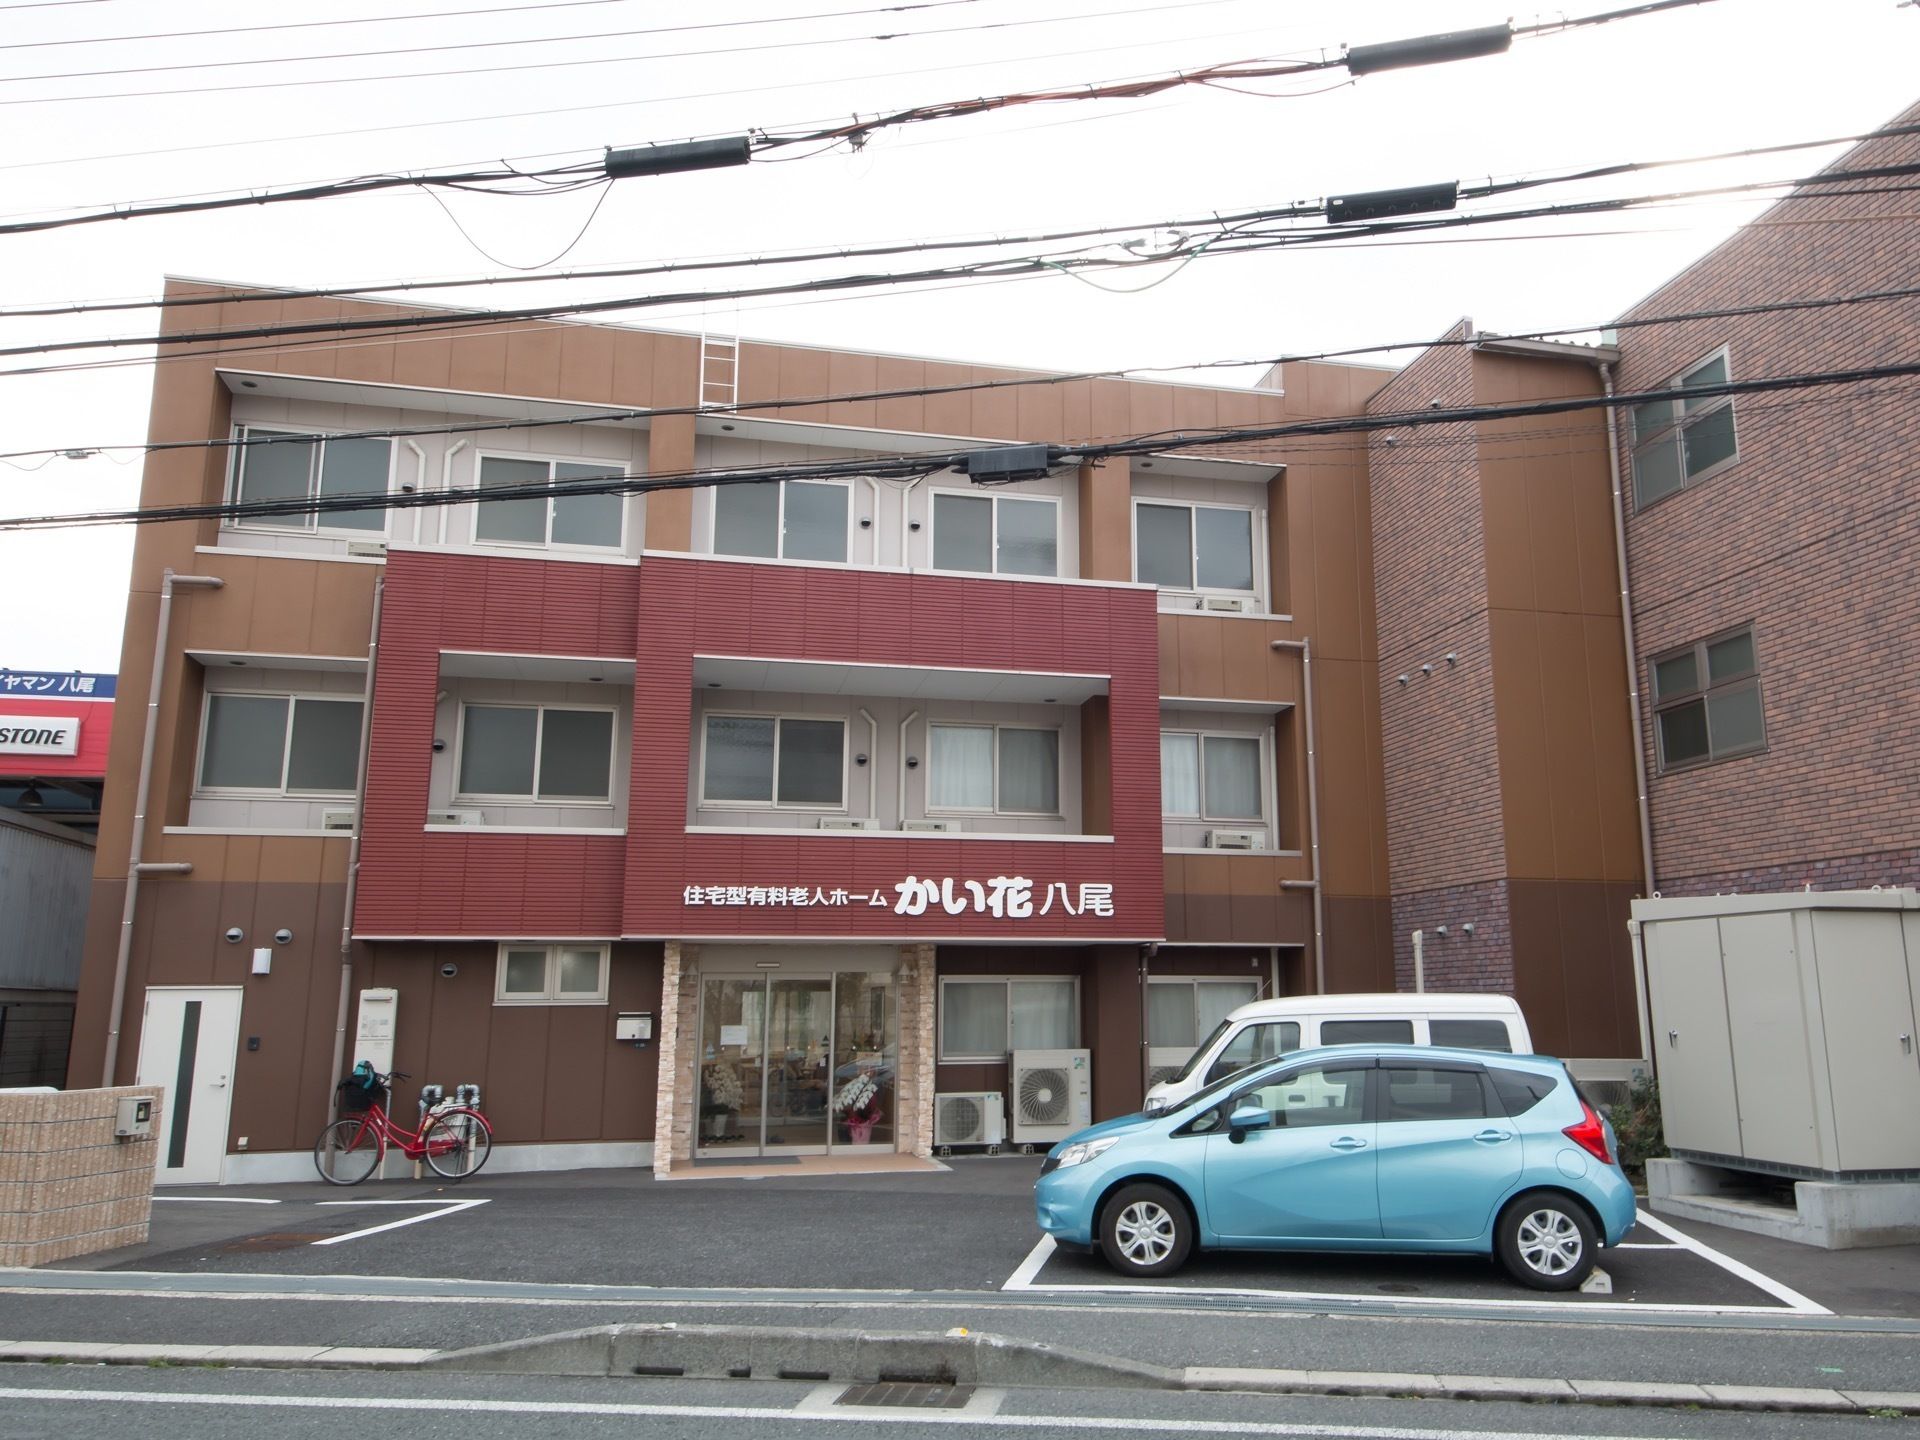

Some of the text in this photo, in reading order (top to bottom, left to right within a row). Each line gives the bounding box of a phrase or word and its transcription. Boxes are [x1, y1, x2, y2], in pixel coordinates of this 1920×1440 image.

[58, 676, 96, 693] 八尾
[683, 875, 1115, 918] 住宅型有料老人ホーム かい花 八尾
